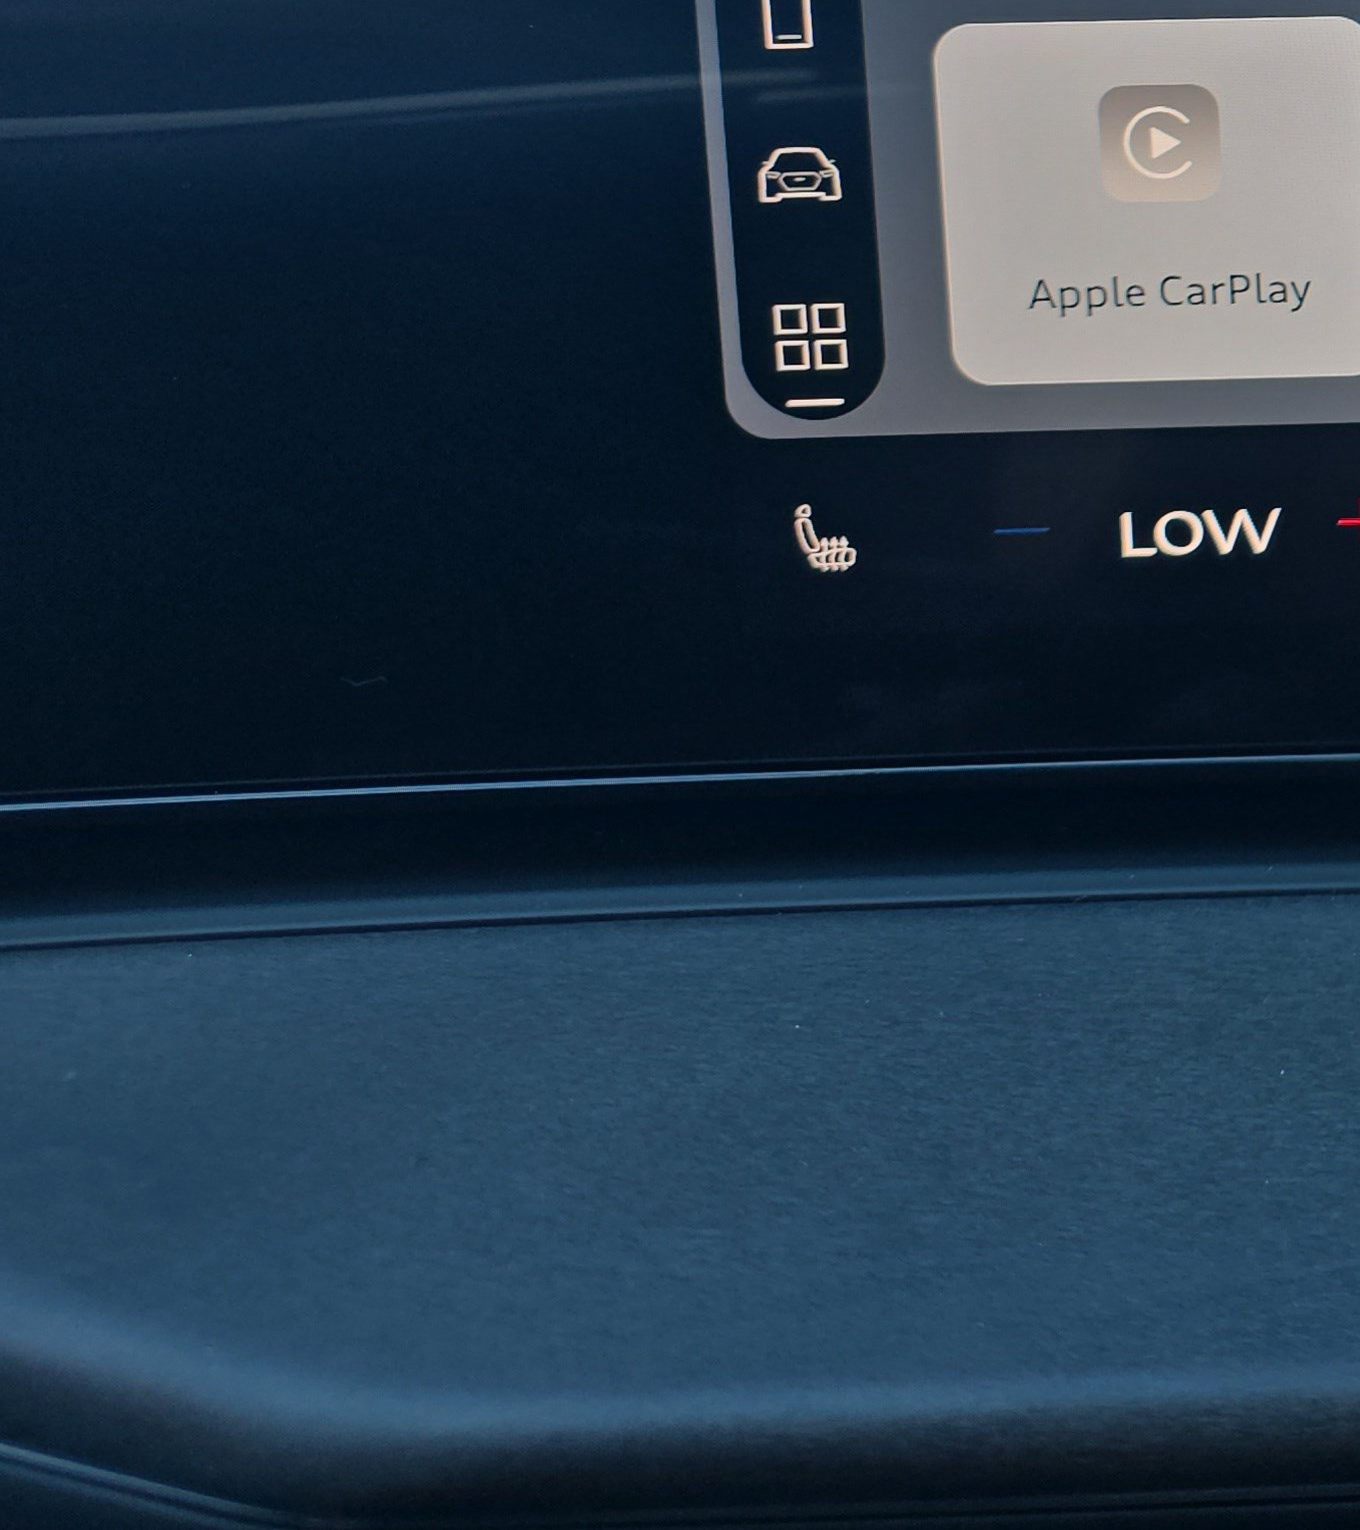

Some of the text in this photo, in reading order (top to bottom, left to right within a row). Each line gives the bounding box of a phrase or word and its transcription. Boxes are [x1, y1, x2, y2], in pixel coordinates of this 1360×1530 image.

[1029, 273, 1311, 317] Apple CarPlay
[1120, 508, 1281, 557] LOW
